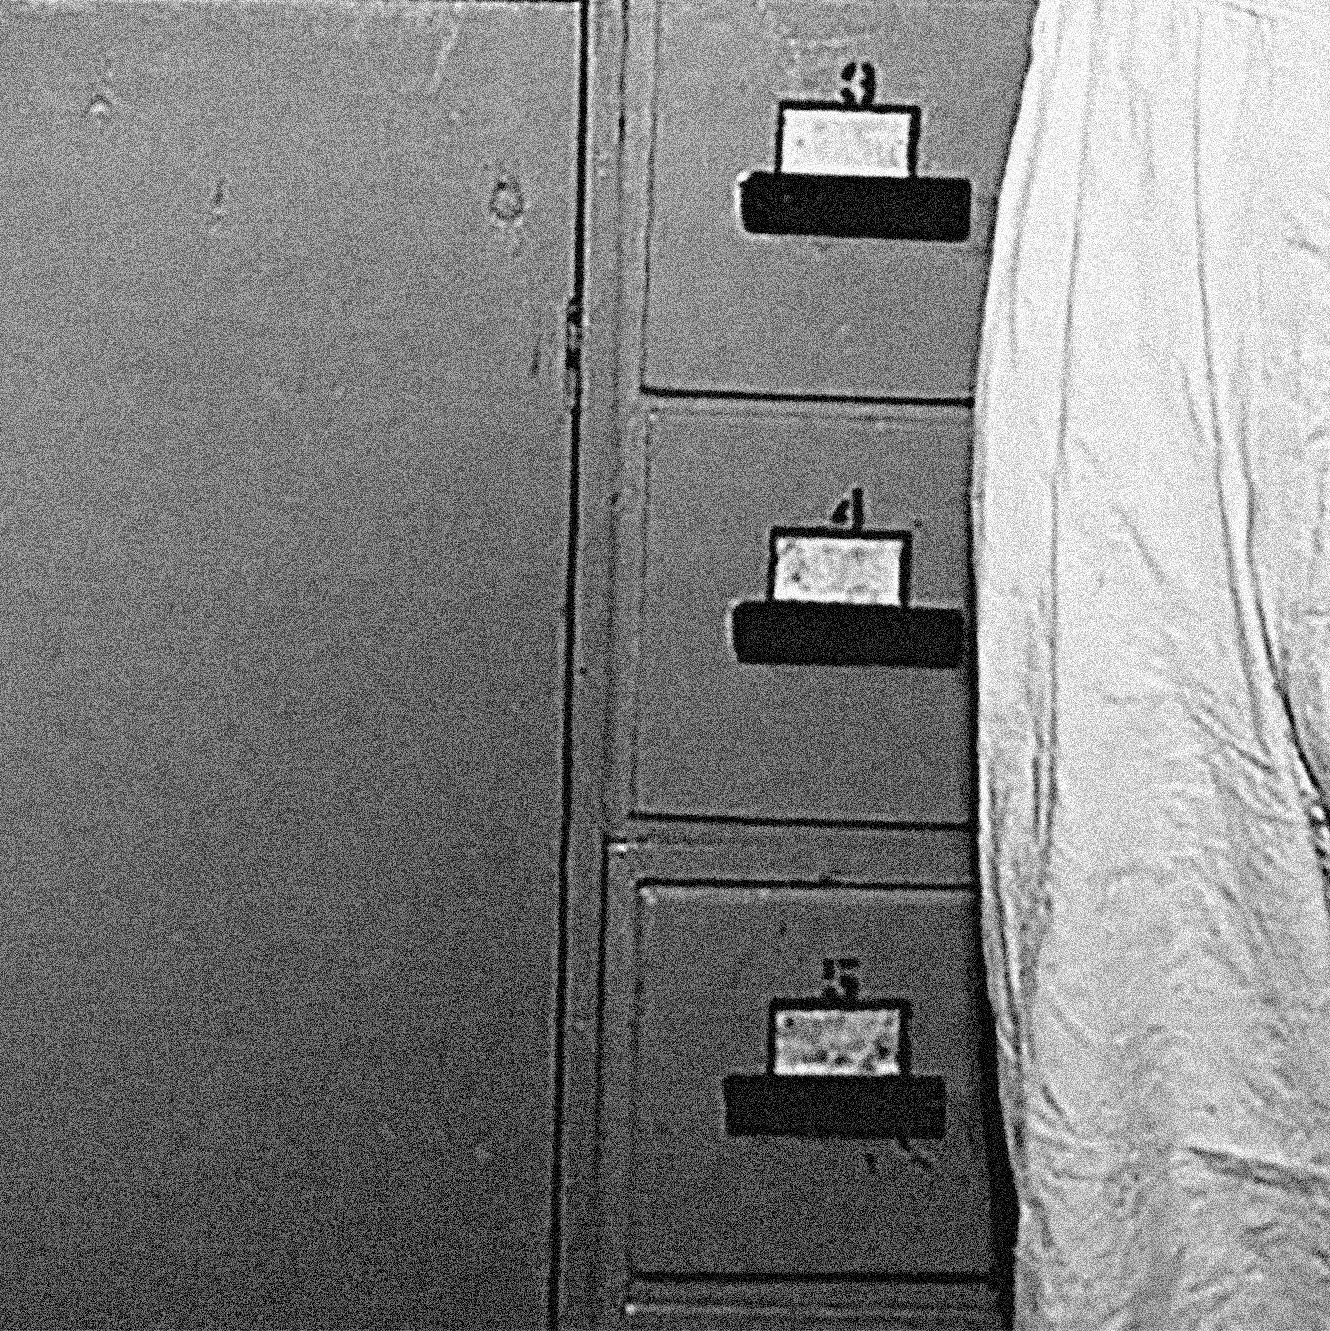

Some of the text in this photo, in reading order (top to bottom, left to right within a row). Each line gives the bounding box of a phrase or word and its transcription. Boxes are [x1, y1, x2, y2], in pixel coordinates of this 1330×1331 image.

[840, 61, 875, 107] 3
[831, 486, 864, 533] 4
[822, 958, 861, 1001] 5
